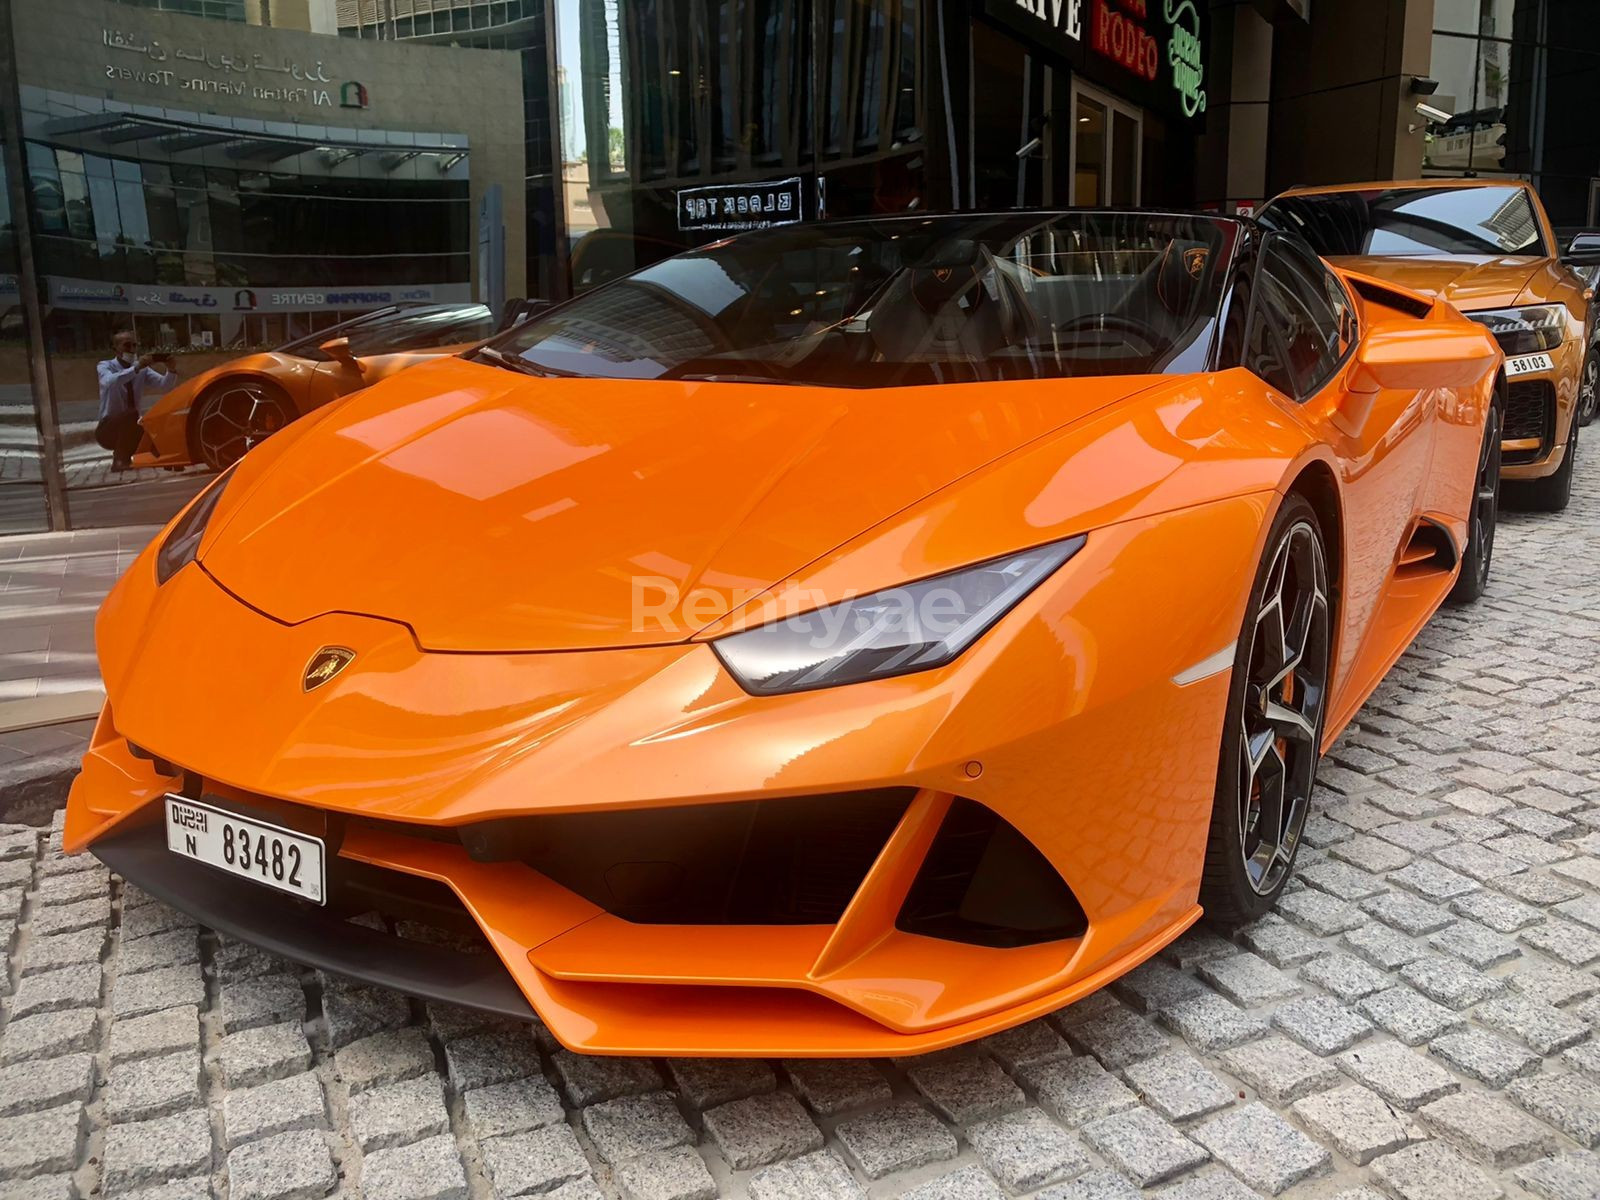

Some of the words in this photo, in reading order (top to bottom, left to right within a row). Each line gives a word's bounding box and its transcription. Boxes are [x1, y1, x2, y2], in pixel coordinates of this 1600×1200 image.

[1099, 3, 1158, 80] RODEO
[1512, 356, 1546, 372] 58103
[186, 833, 197, 856] N
[223, 823, 302, 888] 83482
